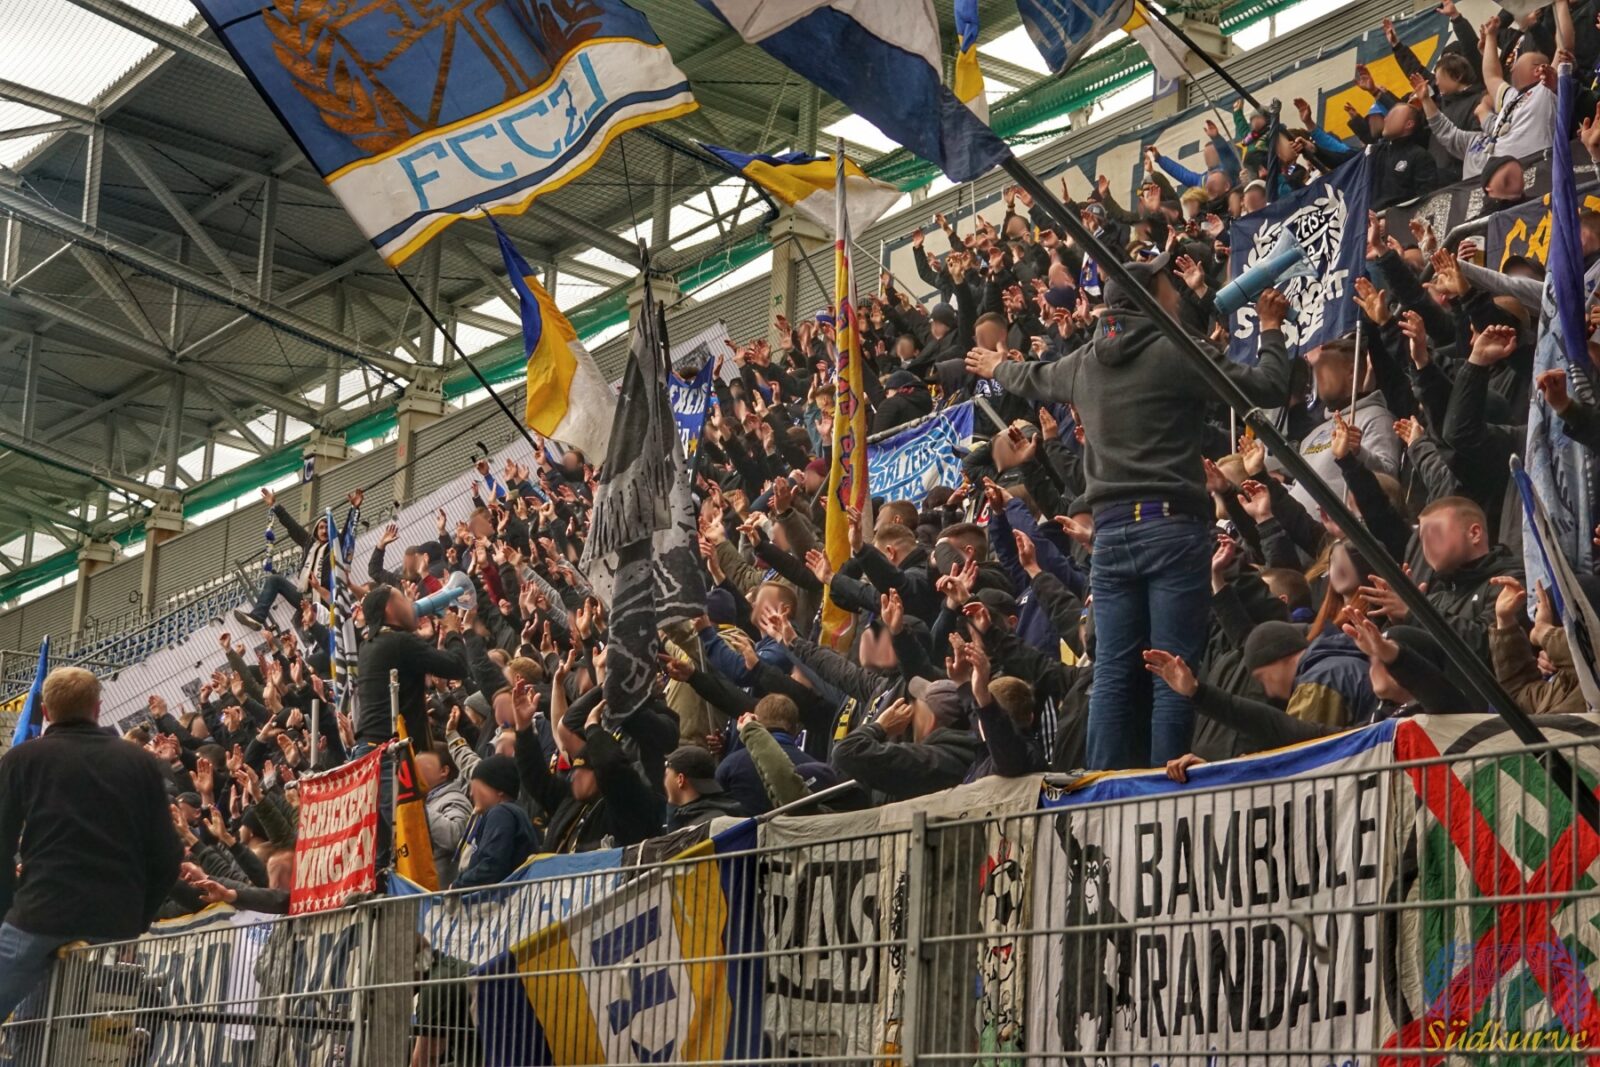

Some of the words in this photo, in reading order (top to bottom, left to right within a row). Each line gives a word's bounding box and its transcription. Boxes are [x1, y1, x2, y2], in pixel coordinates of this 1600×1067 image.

[397, 52, 609, 211] FCCZJ
[1134, 773, 1379, 919] BAMBULE
[1139, 903, 1377, 1038] RANDALE
